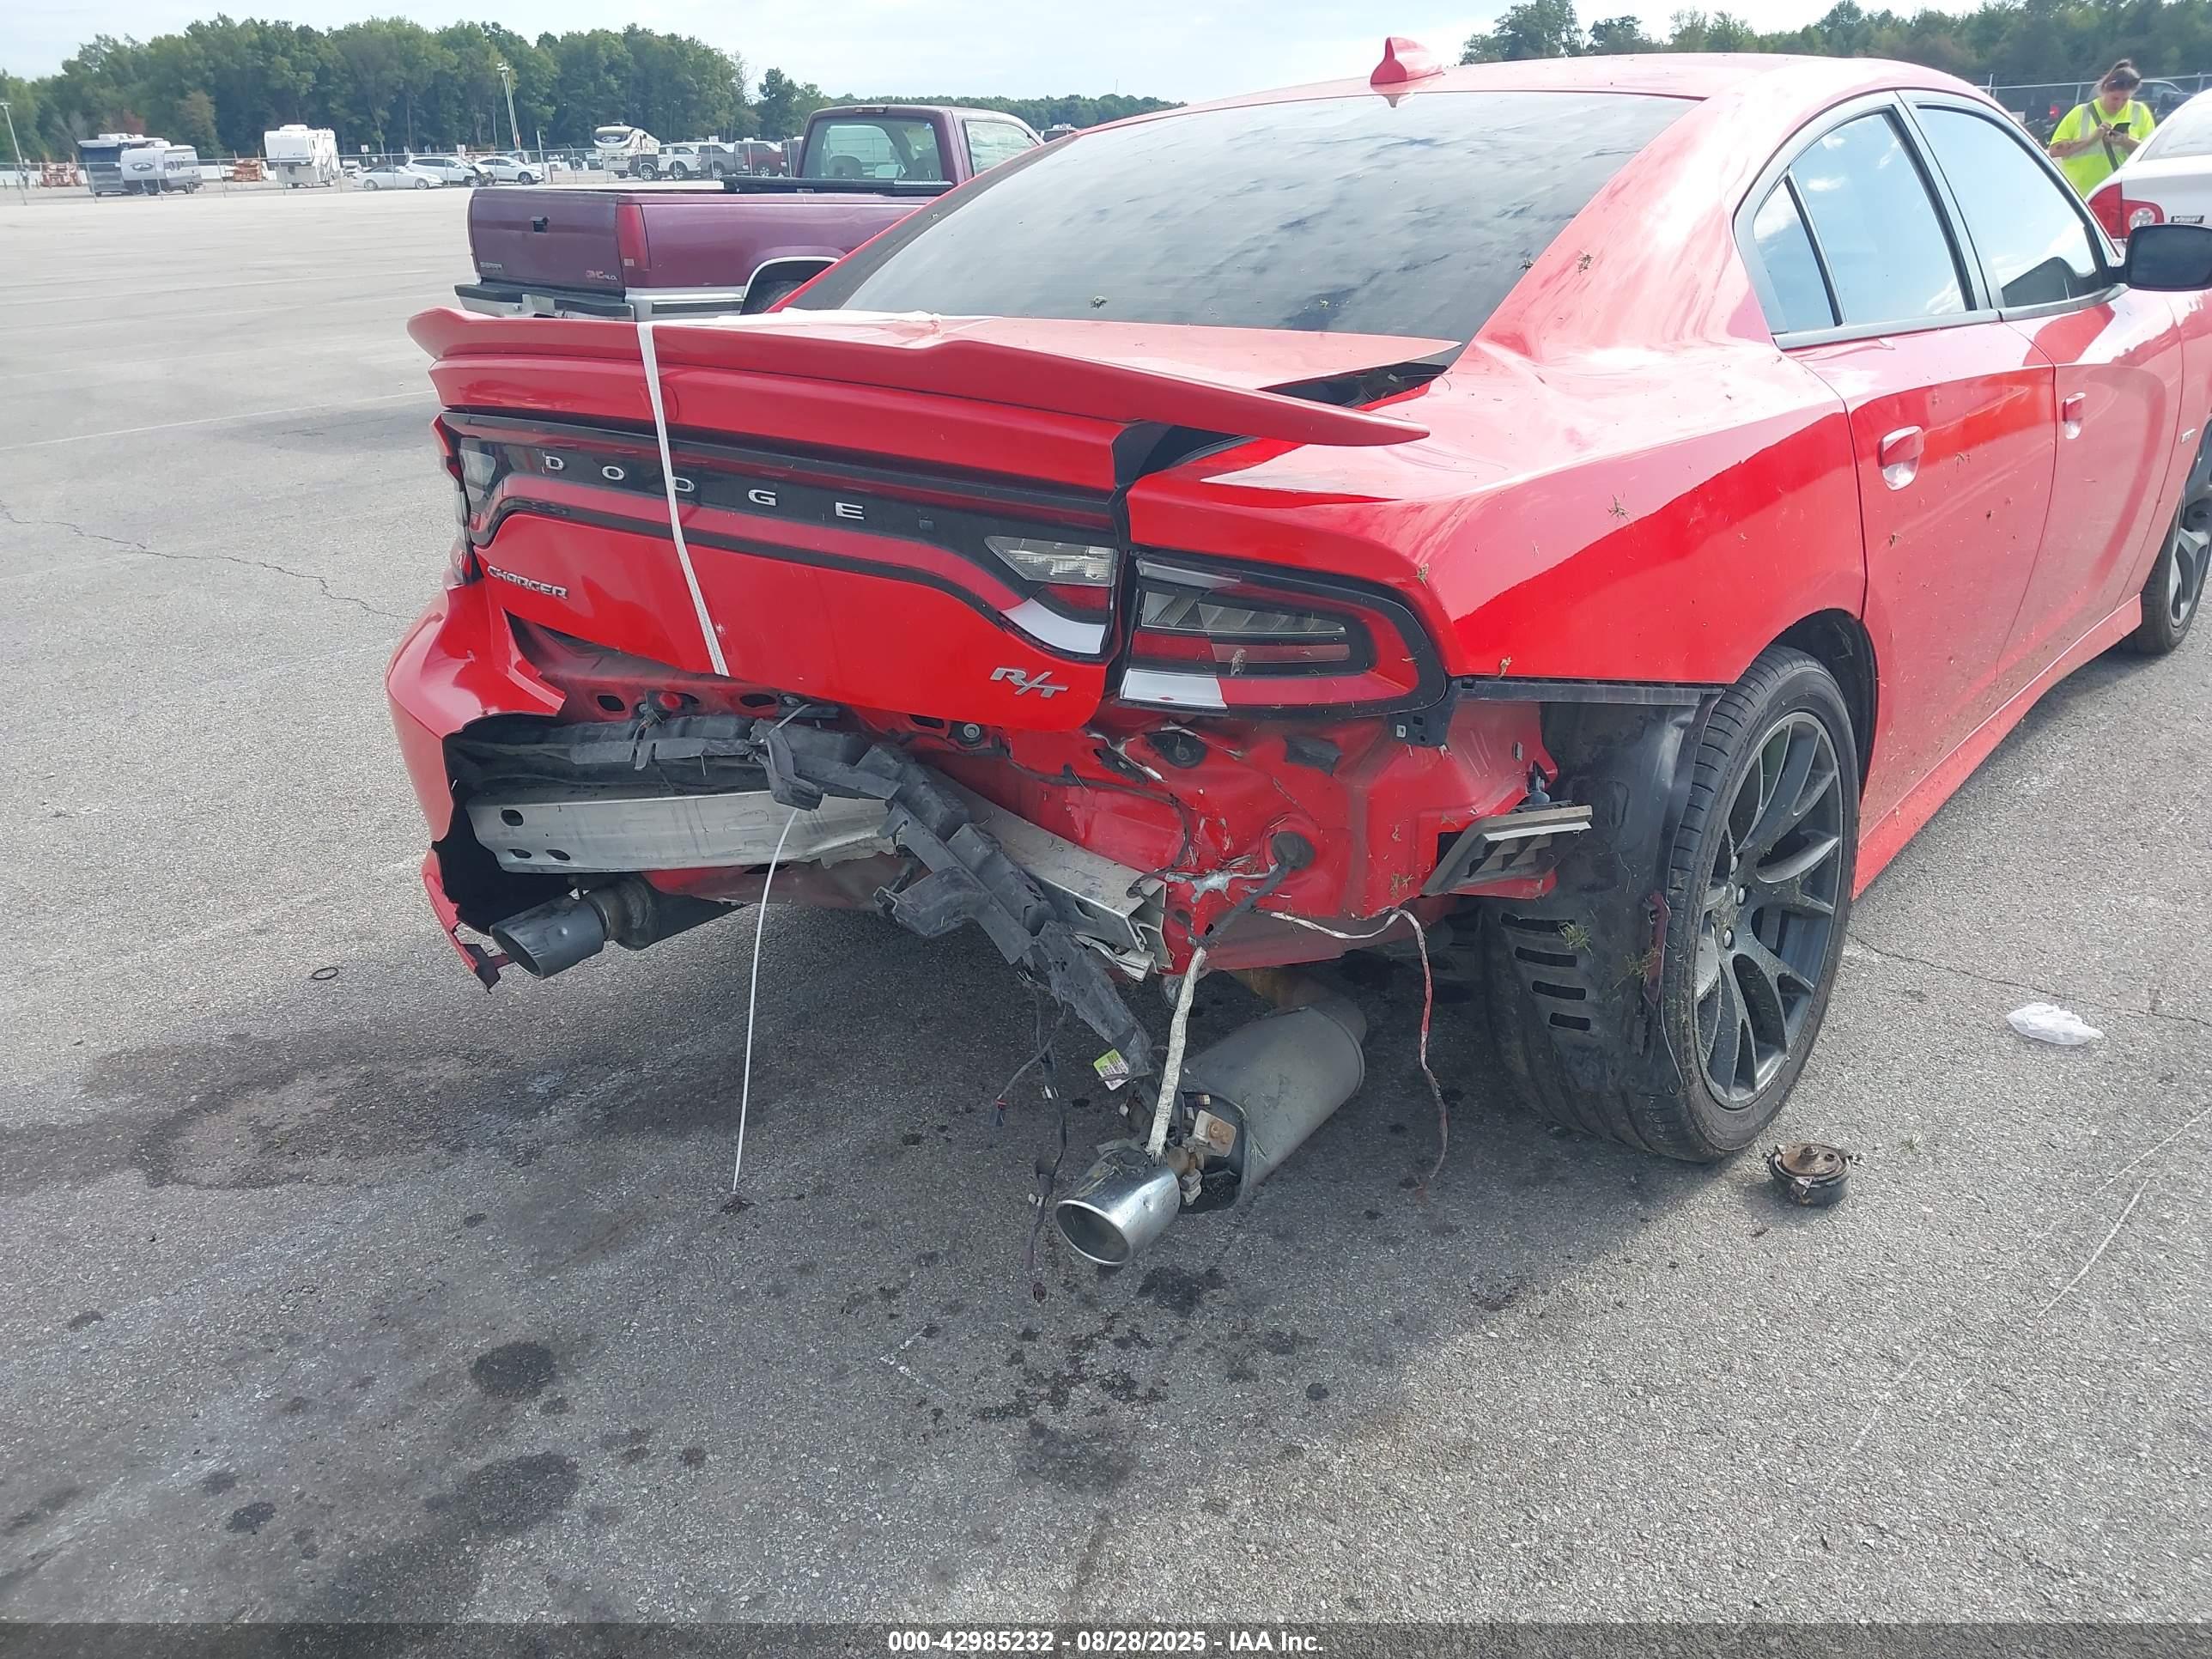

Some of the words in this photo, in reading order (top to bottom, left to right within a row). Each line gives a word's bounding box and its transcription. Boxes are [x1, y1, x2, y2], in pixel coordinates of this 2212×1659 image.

[544, 455, 865, 520] DODGE
[487, 565, 568, 599] CHARGER
[989, 666, 1070, 698] R/T
